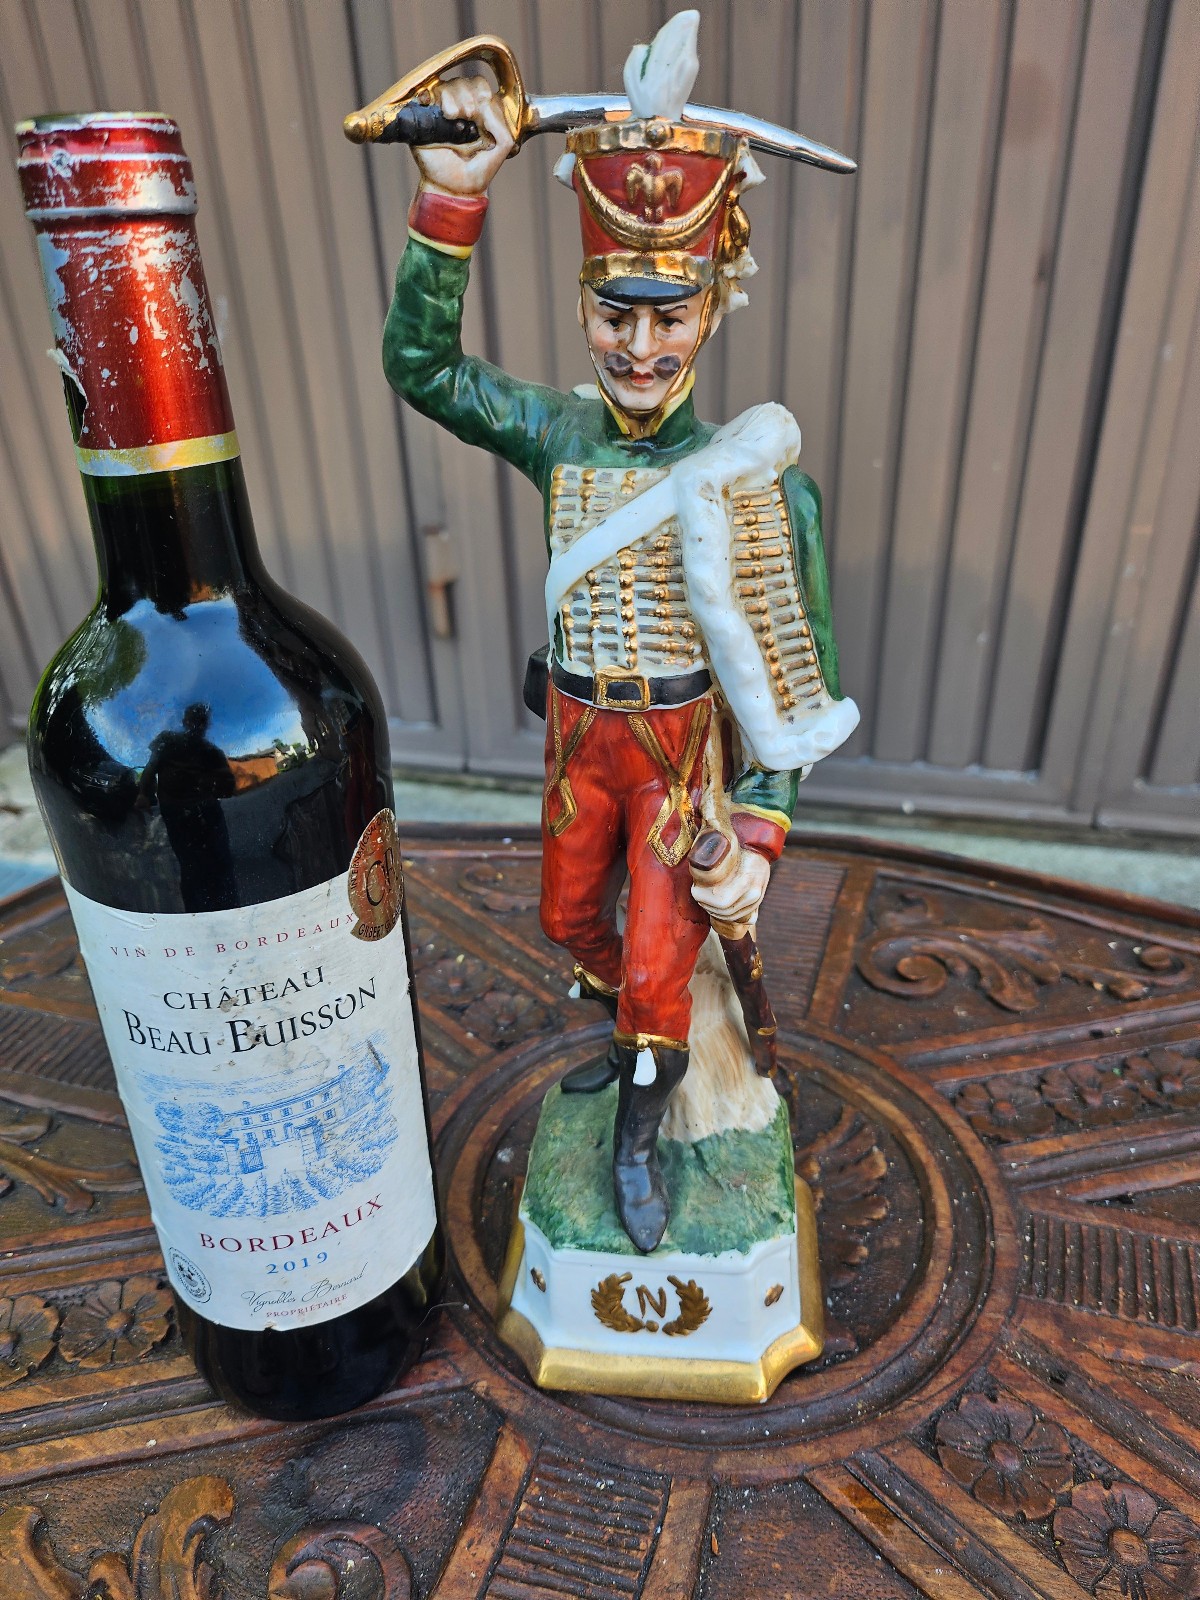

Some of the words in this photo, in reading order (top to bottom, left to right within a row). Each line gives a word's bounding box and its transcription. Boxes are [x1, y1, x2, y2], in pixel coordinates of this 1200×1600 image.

[110, 945, 148, 959] VIN
[164, 945, 196, 959] DE
[216, 912, 355, 955] BORDEAUX
[163, 965, 325, 1011] CHÂTEAU
[122, 1008, 212, 1056] BEAU
[226, 976, 376, 1054] BUISSON
[199, 1192, 384, 1253] BORDEAUX
[266, 1251, 328, 1275] 2019
[241, 1290, 297, 1313] Vignobles
[302, 1261, 369, 1303] Bernard
[635, 1283, 668, 1319] N
